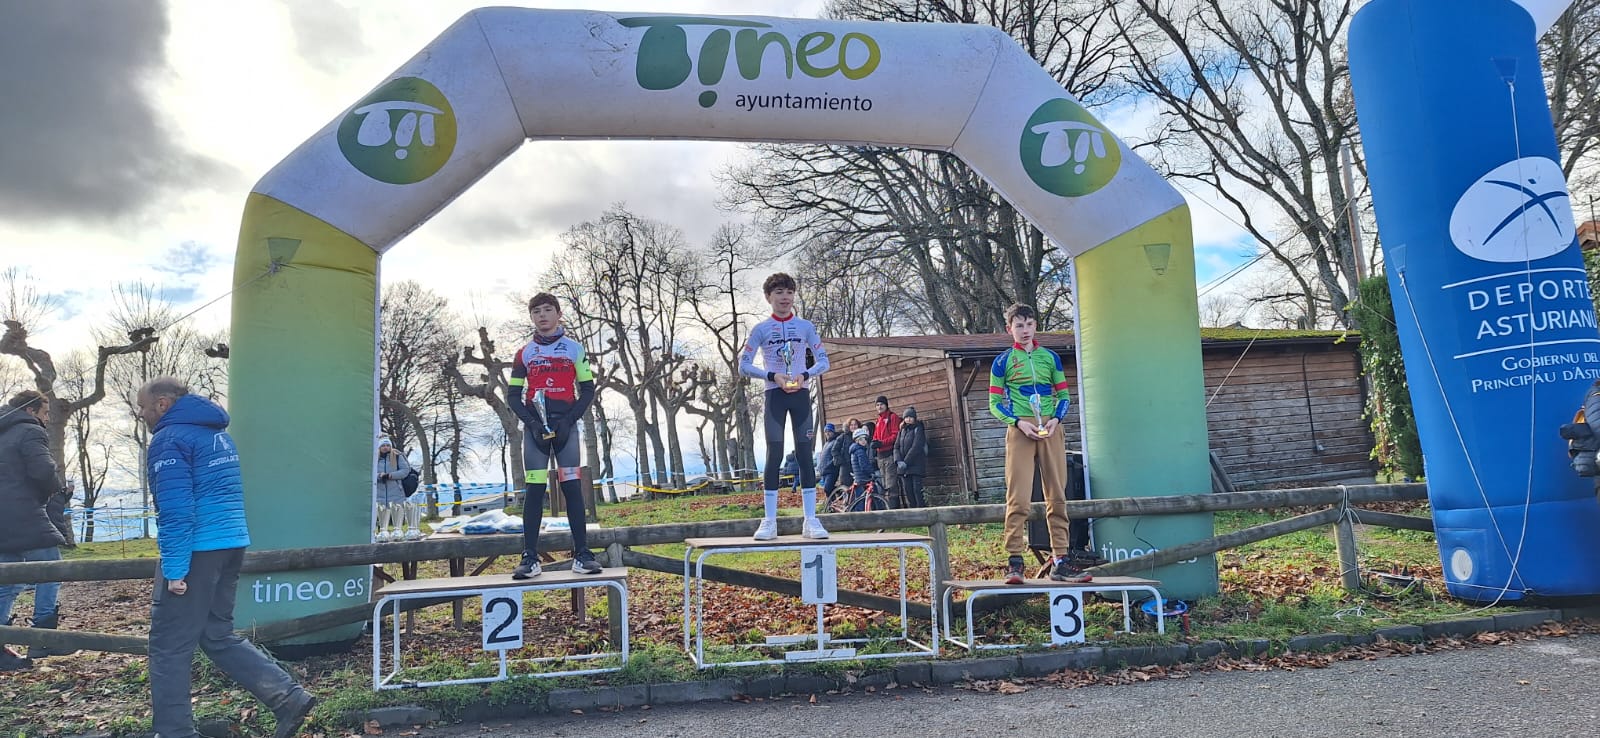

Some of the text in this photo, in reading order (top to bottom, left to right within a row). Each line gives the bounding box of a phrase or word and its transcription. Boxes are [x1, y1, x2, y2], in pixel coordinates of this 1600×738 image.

[617, 16, 881, 108] Tineo
[735, 92, 873, 112] ayuntamiento
[1476, 310, 1597, 340] ASTURIANU
[252, 576, 364, 603] tineo.es
[804, 554, 824, 599] 1
[485, 597, 519, 644] 2
[1053, 594, 1082, 637] 3
